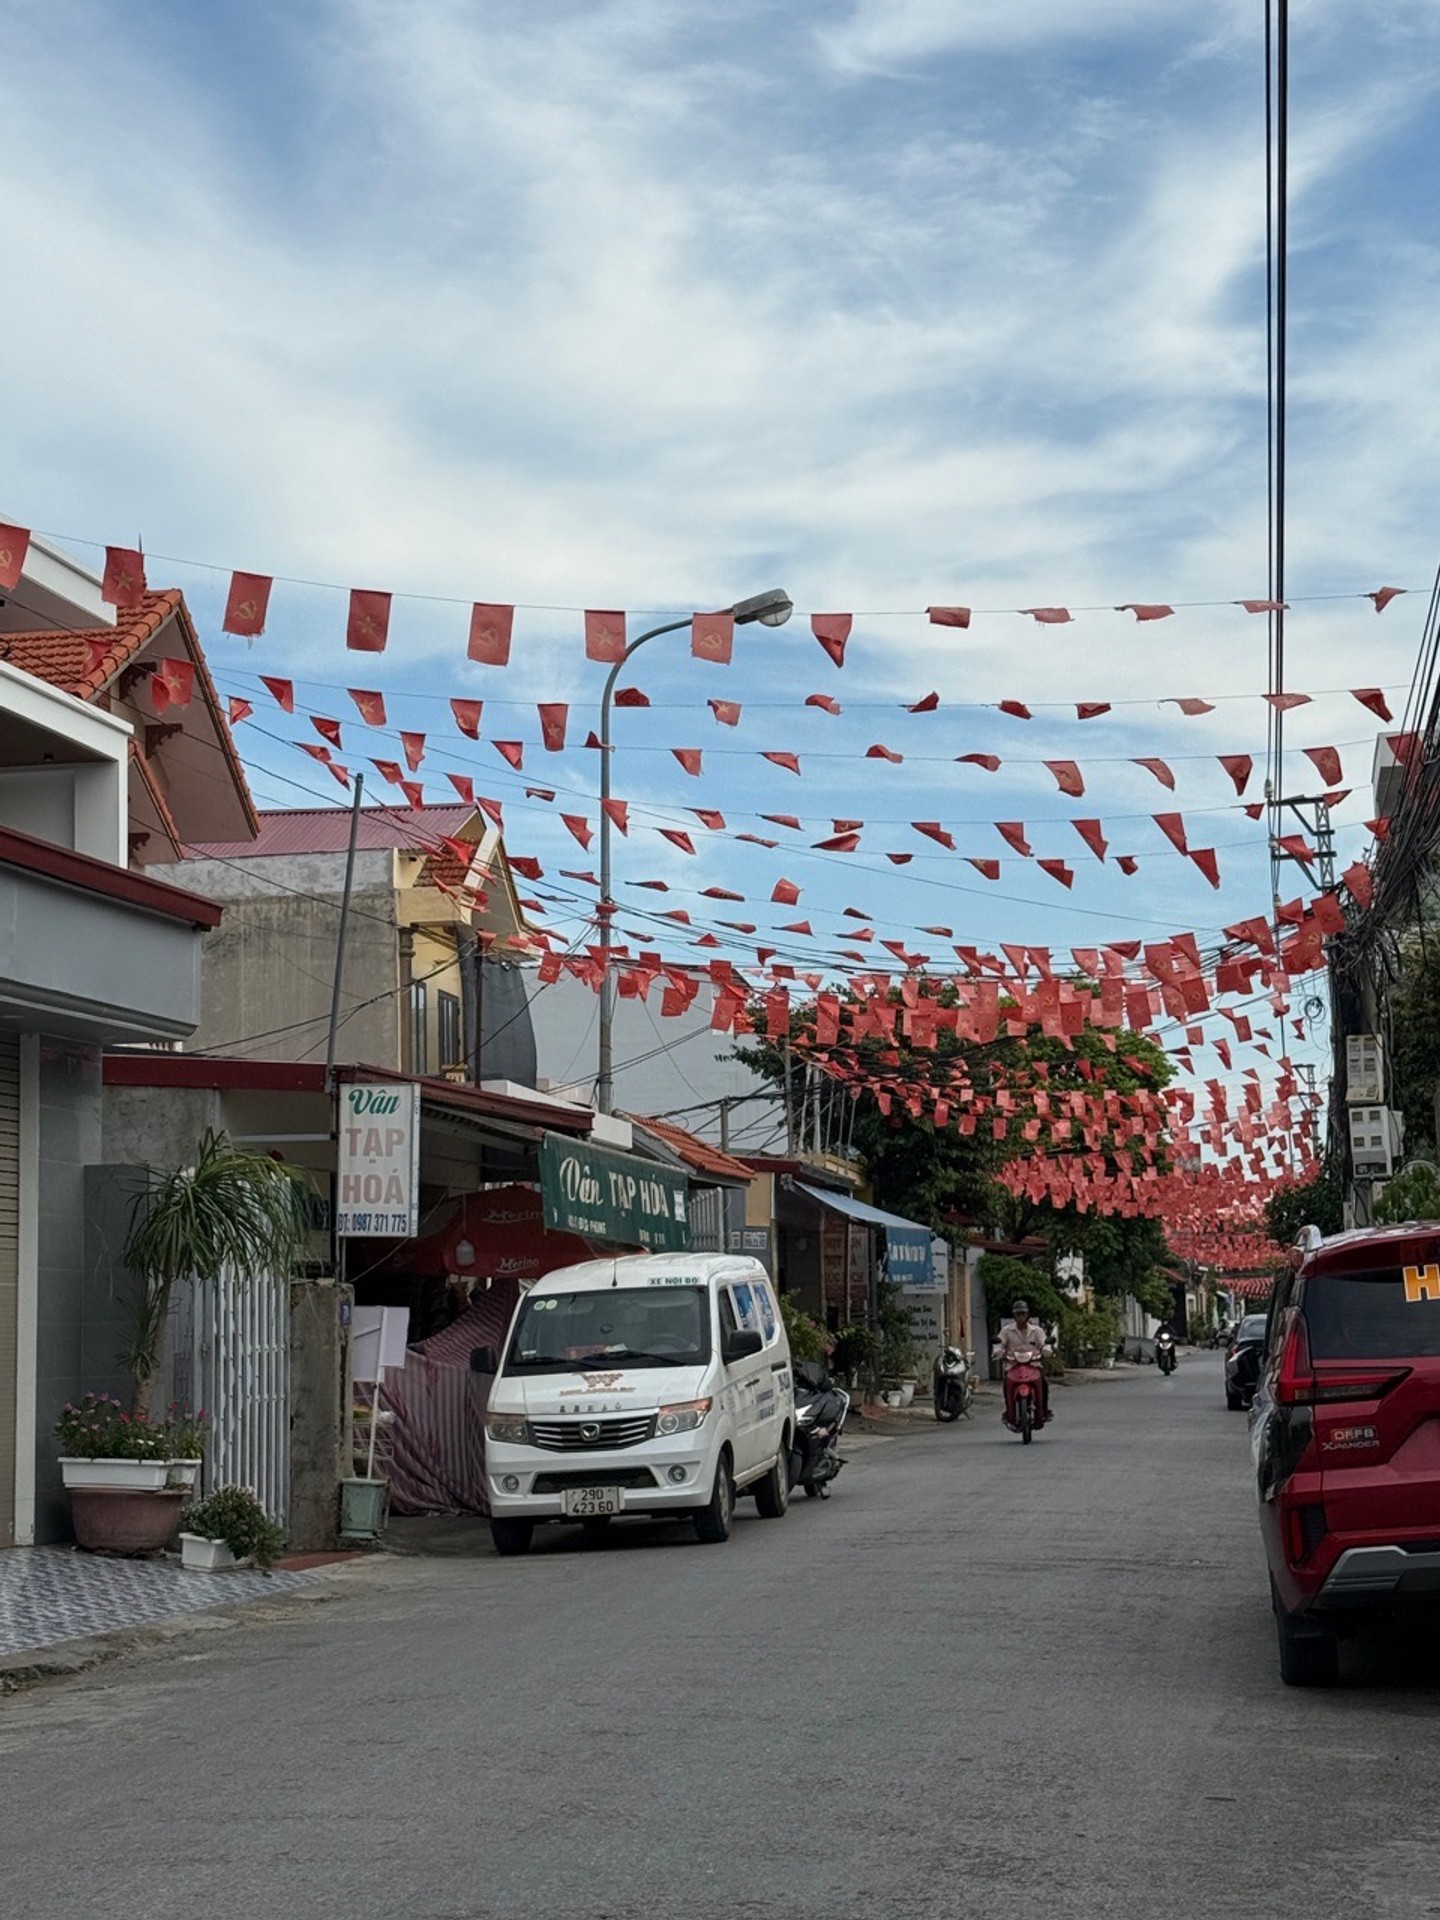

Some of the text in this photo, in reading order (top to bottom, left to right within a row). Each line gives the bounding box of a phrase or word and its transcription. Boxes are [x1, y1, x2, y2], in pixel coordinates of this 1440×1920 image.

[348, 1089, 399, 1115] Vân
[345, 1128, 405, 1164] TẠP
[342, 1169, 404, 1204] HOÁ
[559, 1157, 604, 1205] Vân
[608, 1171, 636, 1217] TẠP
[374, 1213, 389, 1232] 371
[391, 1213, 407, 1232] 775
[500, 1256, 540, 1270] Merino
[581, 1489, 604, 1501] 29D
